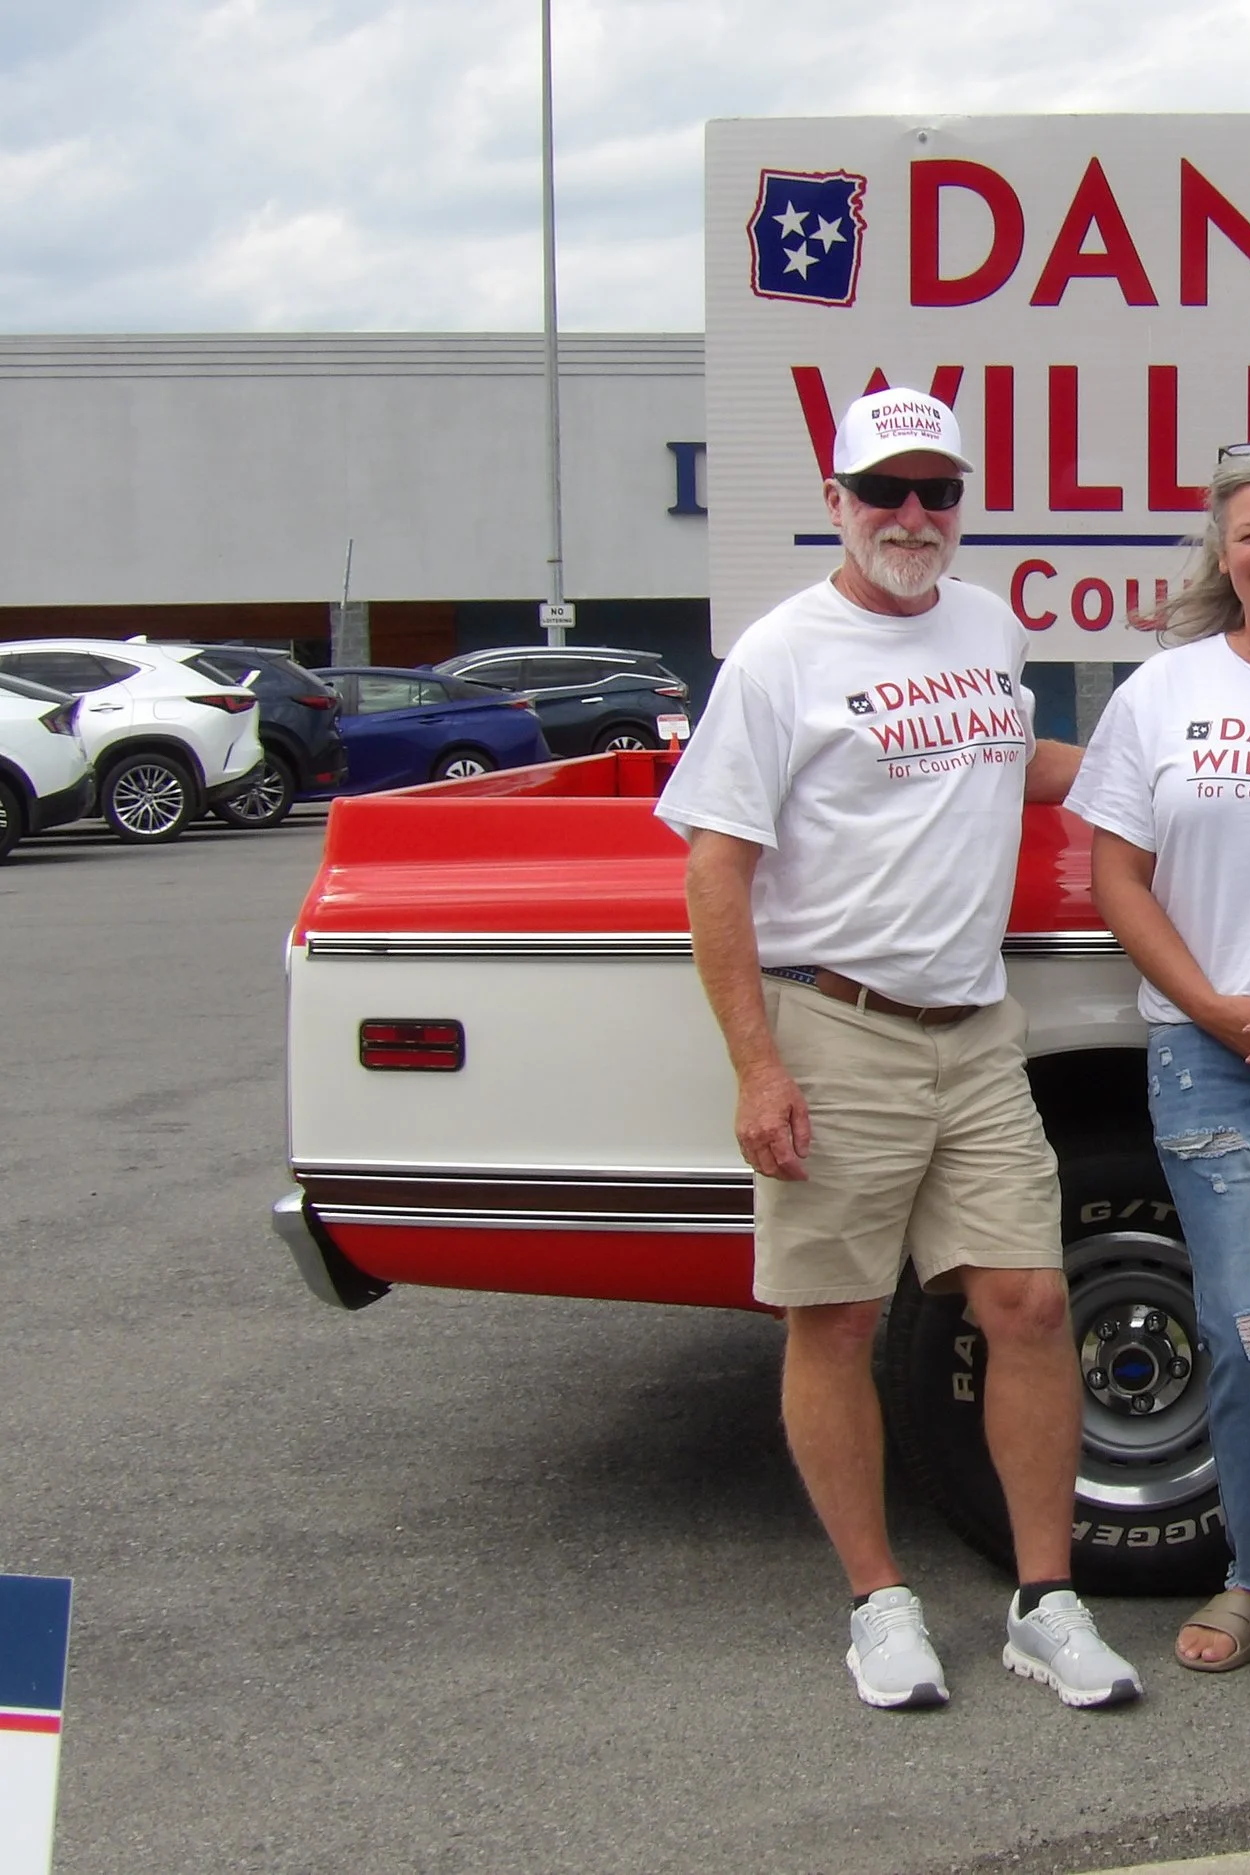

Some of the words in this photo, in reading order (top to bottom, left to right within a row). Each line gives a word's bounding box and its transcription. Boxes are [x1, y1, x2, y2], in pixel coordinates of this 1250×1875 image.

[882, 402, 932, 417] DANNY
[875, 416, 942, 433] WILLIAMS
[1010, 559, 1193, 632] Cou
[551, 607, 564, 616] NO
[875, 668, 996, 711] DANNY
[869, 707, 1024, 754] WILLIAMS
[888, 762, 911, 779] for
[919, 752, 977, 773] County
[982, 748, 1019, 764] Mayor
[1197, 783, 1224, 798] for
